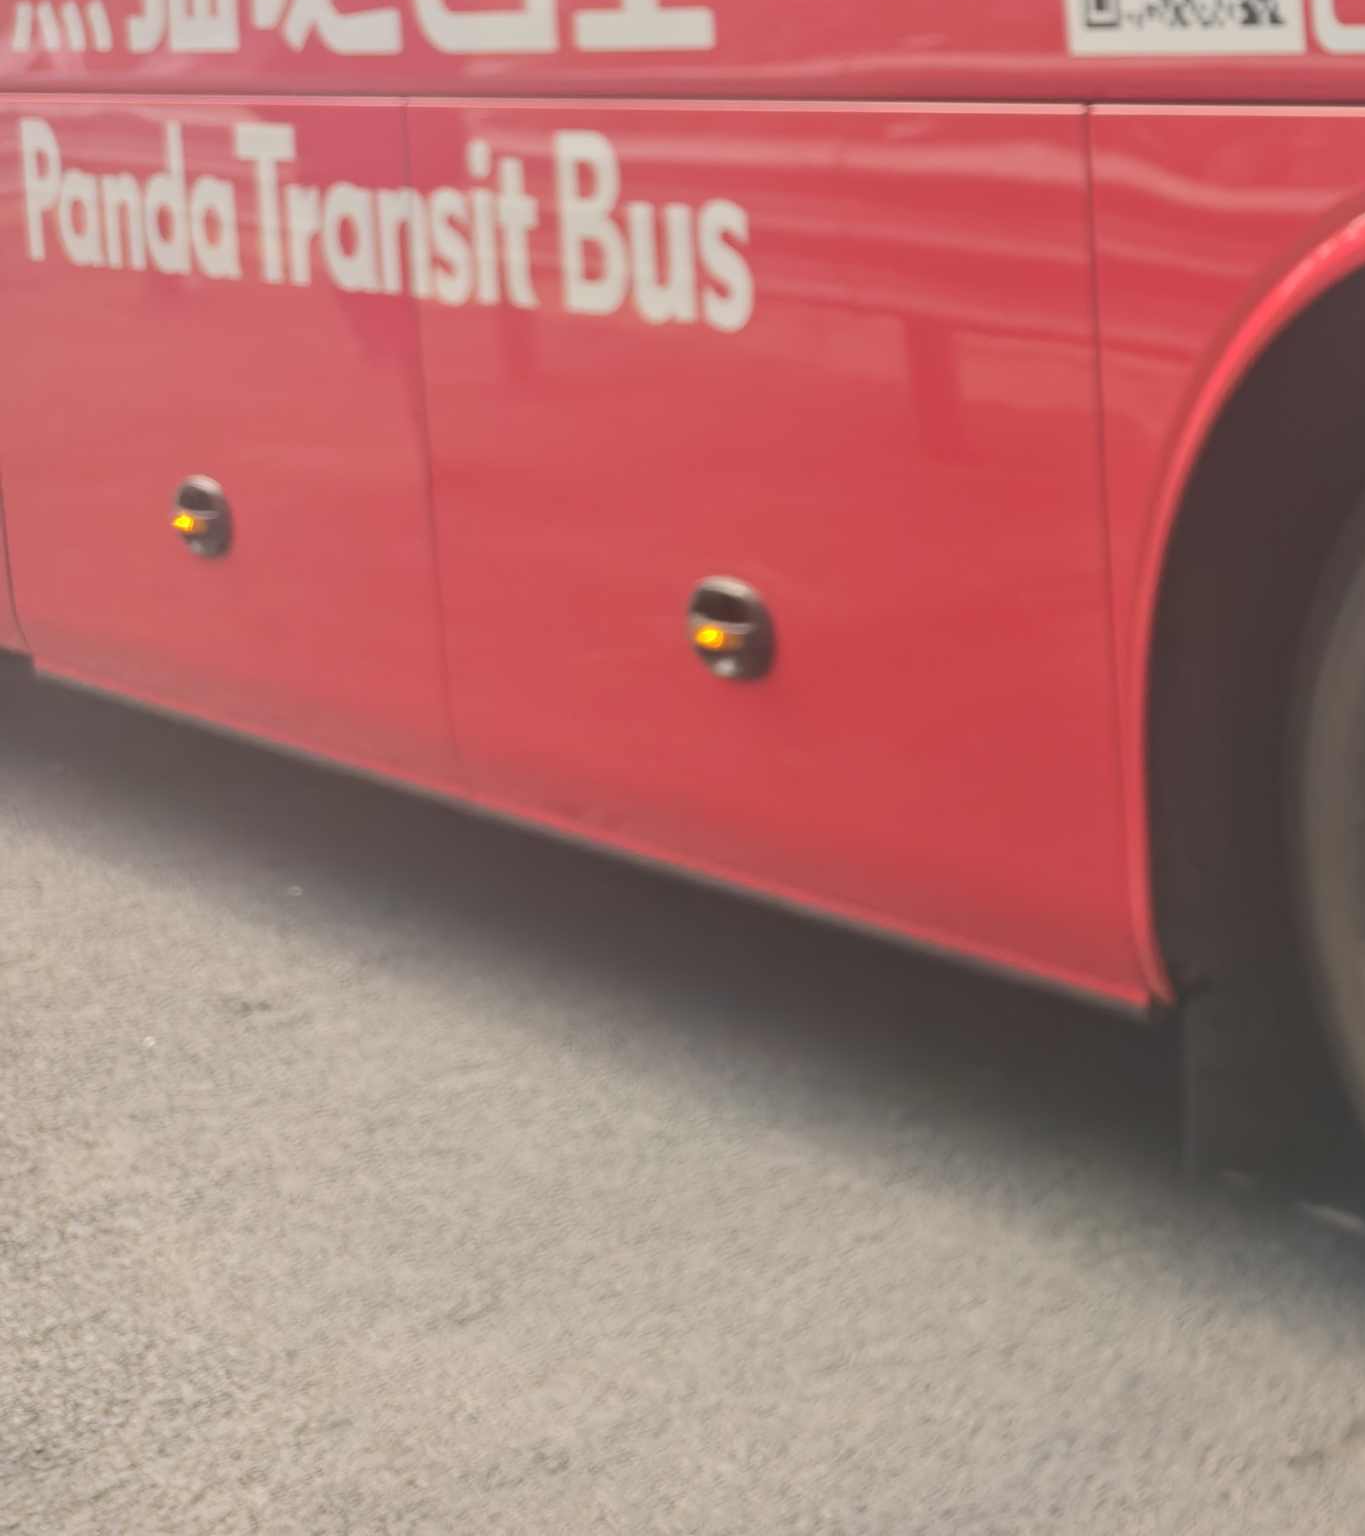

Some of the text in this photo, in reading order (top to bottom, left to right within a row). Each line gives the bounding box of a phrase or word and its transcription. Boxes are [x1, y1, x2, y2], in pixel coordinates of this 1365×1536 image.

[19, 117, 755, 332] Panda Transit Bus
